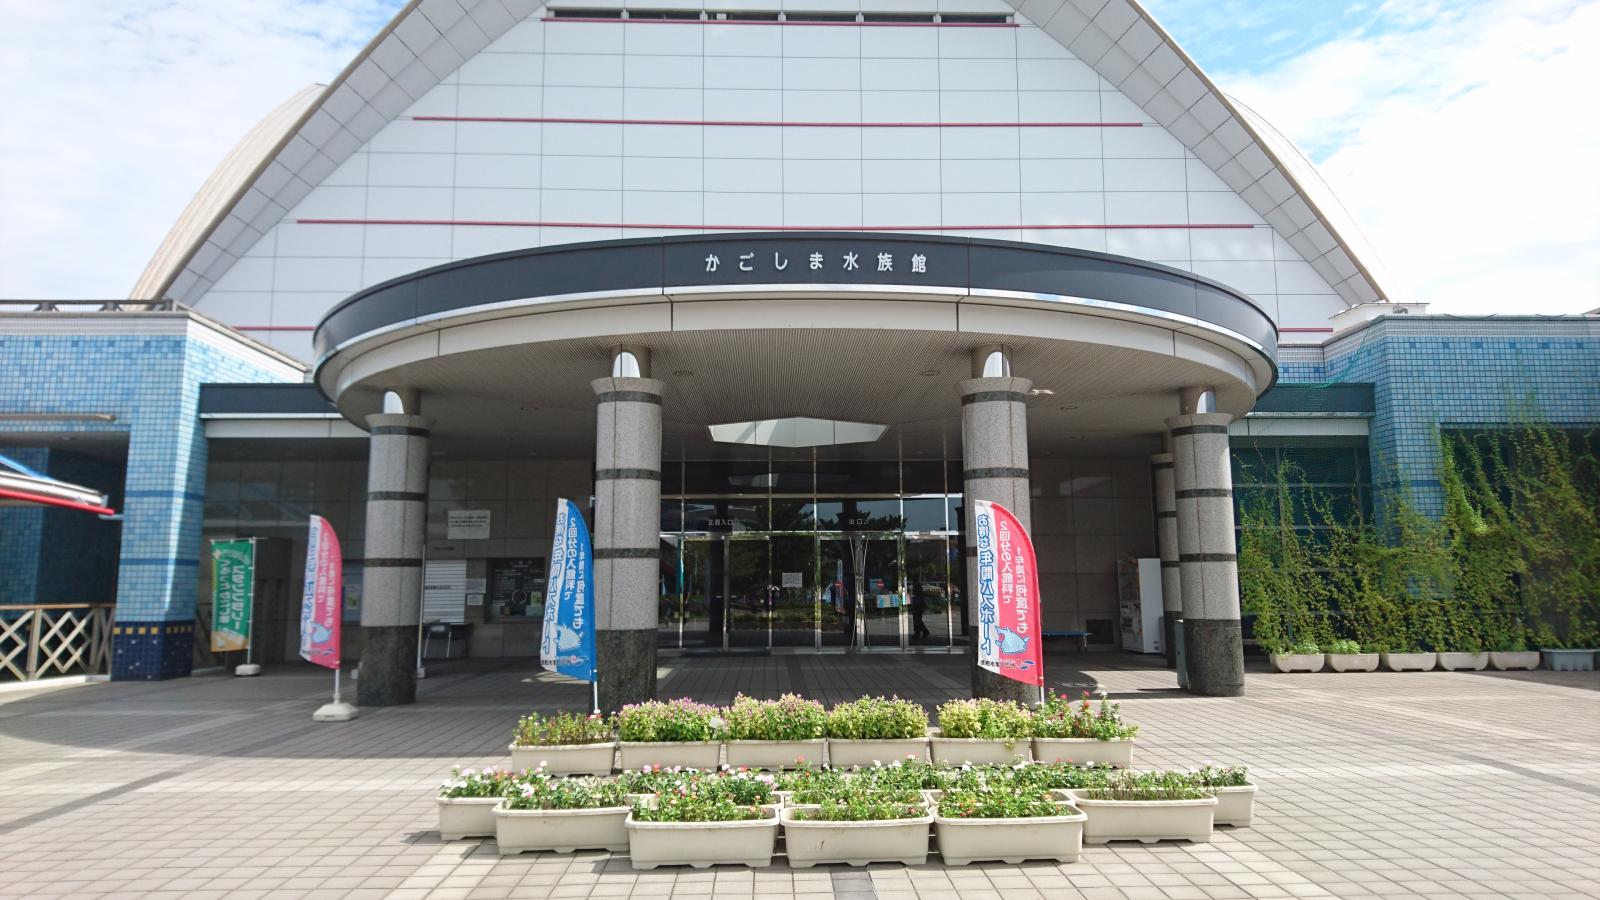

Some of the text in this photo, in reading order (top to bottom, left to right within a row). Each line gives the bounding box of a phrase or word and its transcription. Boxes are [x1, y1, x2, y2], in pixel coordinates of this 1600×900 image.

[705, 252, 927, 273] かごしま水族館
